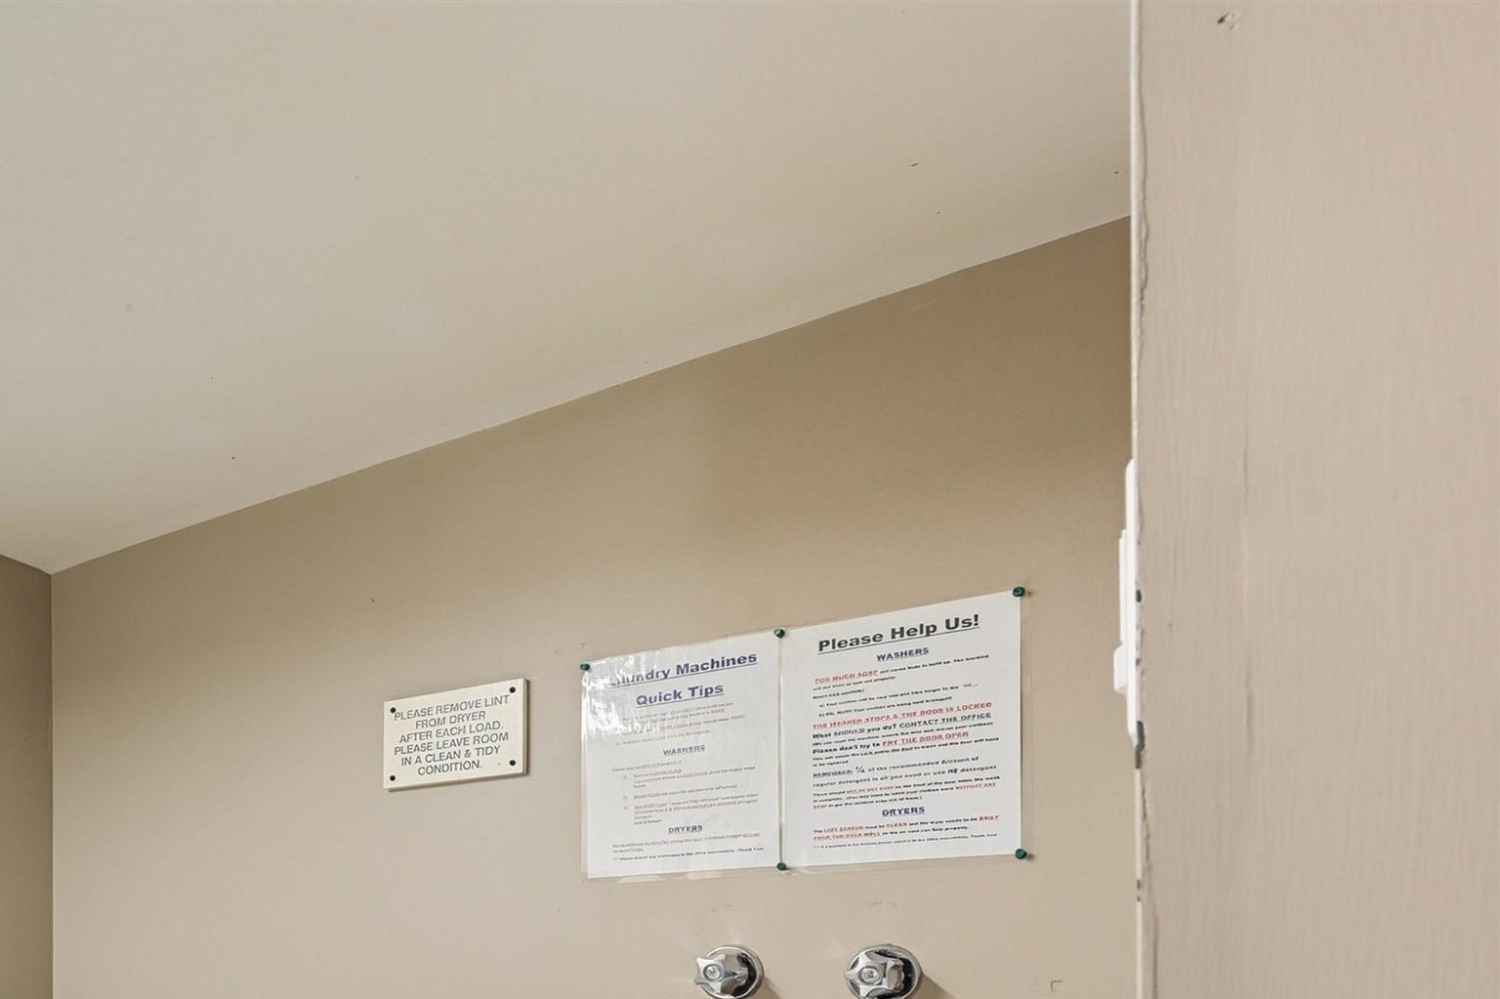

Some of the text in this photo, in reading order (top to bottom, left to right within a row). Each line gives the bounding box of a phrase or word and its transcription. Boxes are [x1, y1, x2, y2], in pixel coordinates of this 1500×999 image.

[818, 614, 979, 652] Please Help Us!
[876, 647, 929, 661] WASHERS
[675, 653, 757, 675] Machines
[832, 673, 855, 681] MUCH
[857, 670, 878, 678] SOAP
[636, 684, 724, 706] Quick Tips
[394, 694, 510, 721] PLEASE REMOVE LINT
[864, 715, 891, 724] STOPS
[920, 707, 944, 716] DOOR
[956, 702, 992, 711] LOCKED
[415, 711, 486, 729] FROM DRYER
[899, 719, 938, 728] CONTACT
[960, 713, 992, 721] OFFICE
[399, 720, 504, 743] AFTER EACH LOAD.
[901, 737, 918, 745] THE
[920, 734, 944, 743] DOOR
[394, 732, 509, 755] PLEASE LEAVE ROOM
[662, 745, 706, 757] WASHERS
[401, 745, 501, 766] IN A CLEAN & TIDY
[417, 760, 482, 776] CONDITION.
[882, 806, 925, 817] DRYERS
[668, 825, 703, 834] DRYERS
